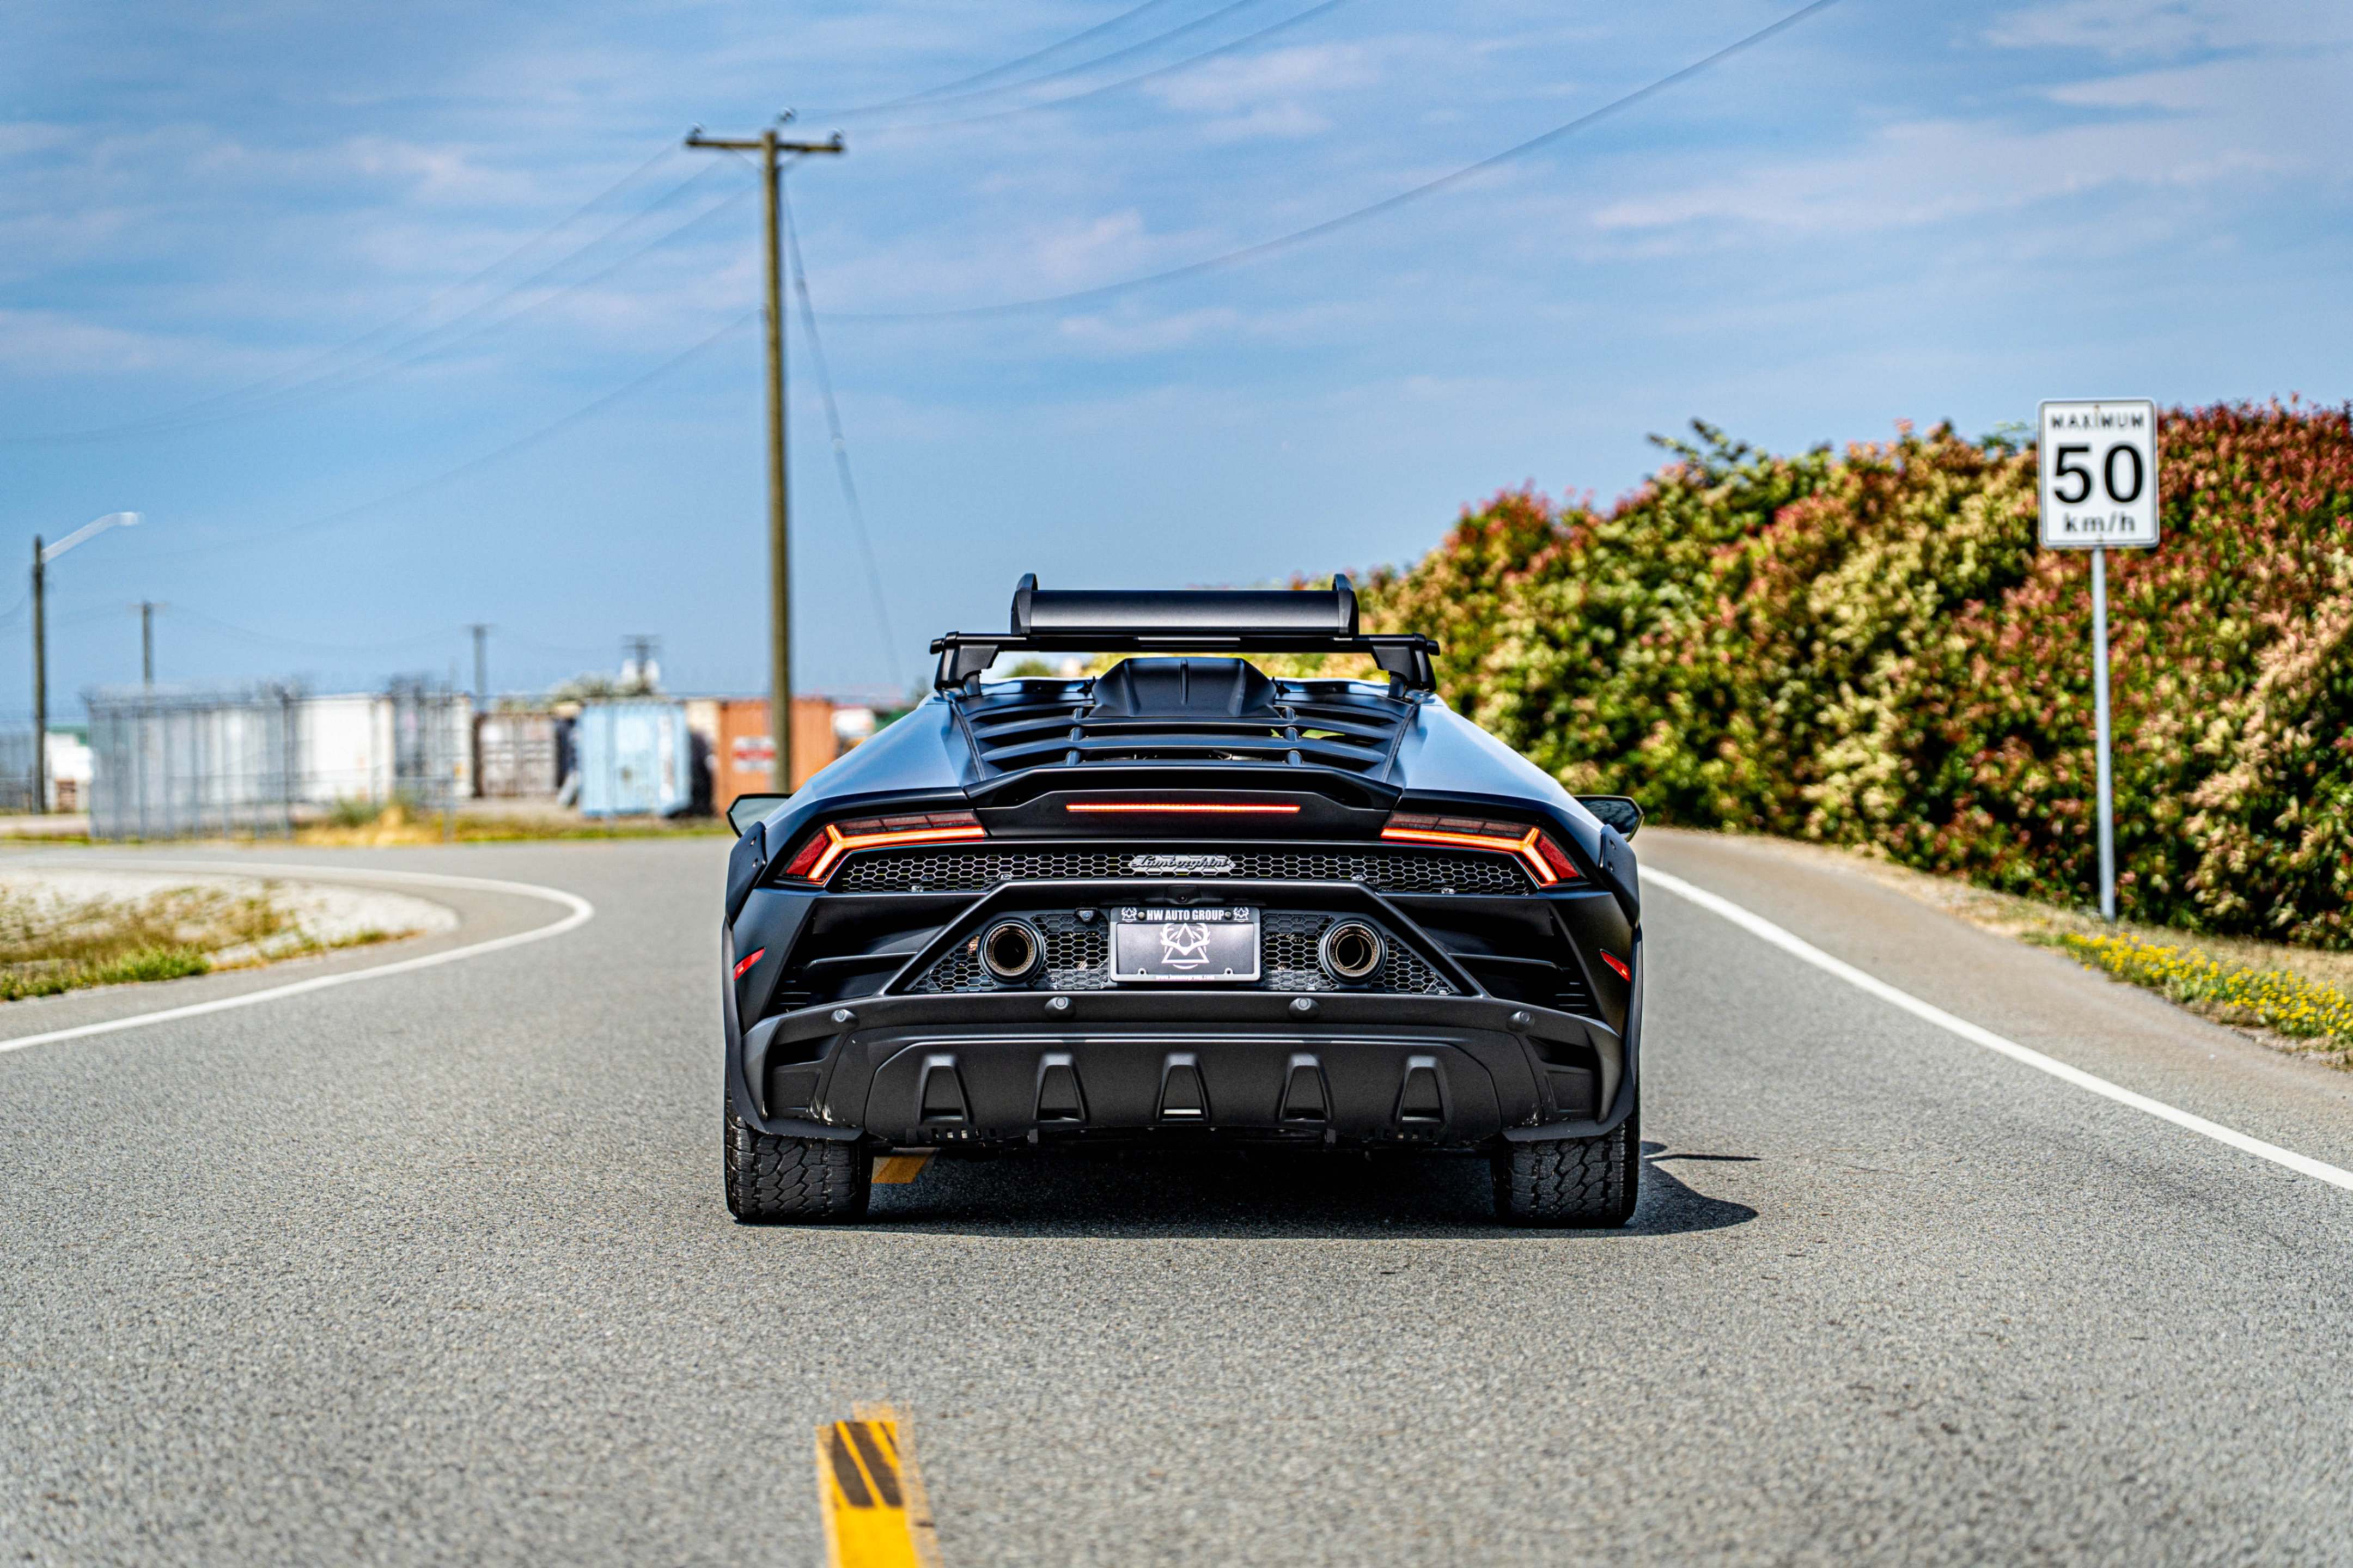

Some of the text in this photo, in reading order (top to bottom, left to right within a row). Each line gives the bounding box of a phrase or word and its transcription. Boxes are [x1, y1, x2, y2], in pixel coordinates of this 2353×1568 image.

[2051, 412, 2144, 428] MAXIMUM
[2053, 444, 2144, 504] 50
[2064, 512, 2136, 532] km/h
[1131, 855, 1230, 870] Lamborghini
[1147, 910, 1224, 920] HW AUTO GROUP
